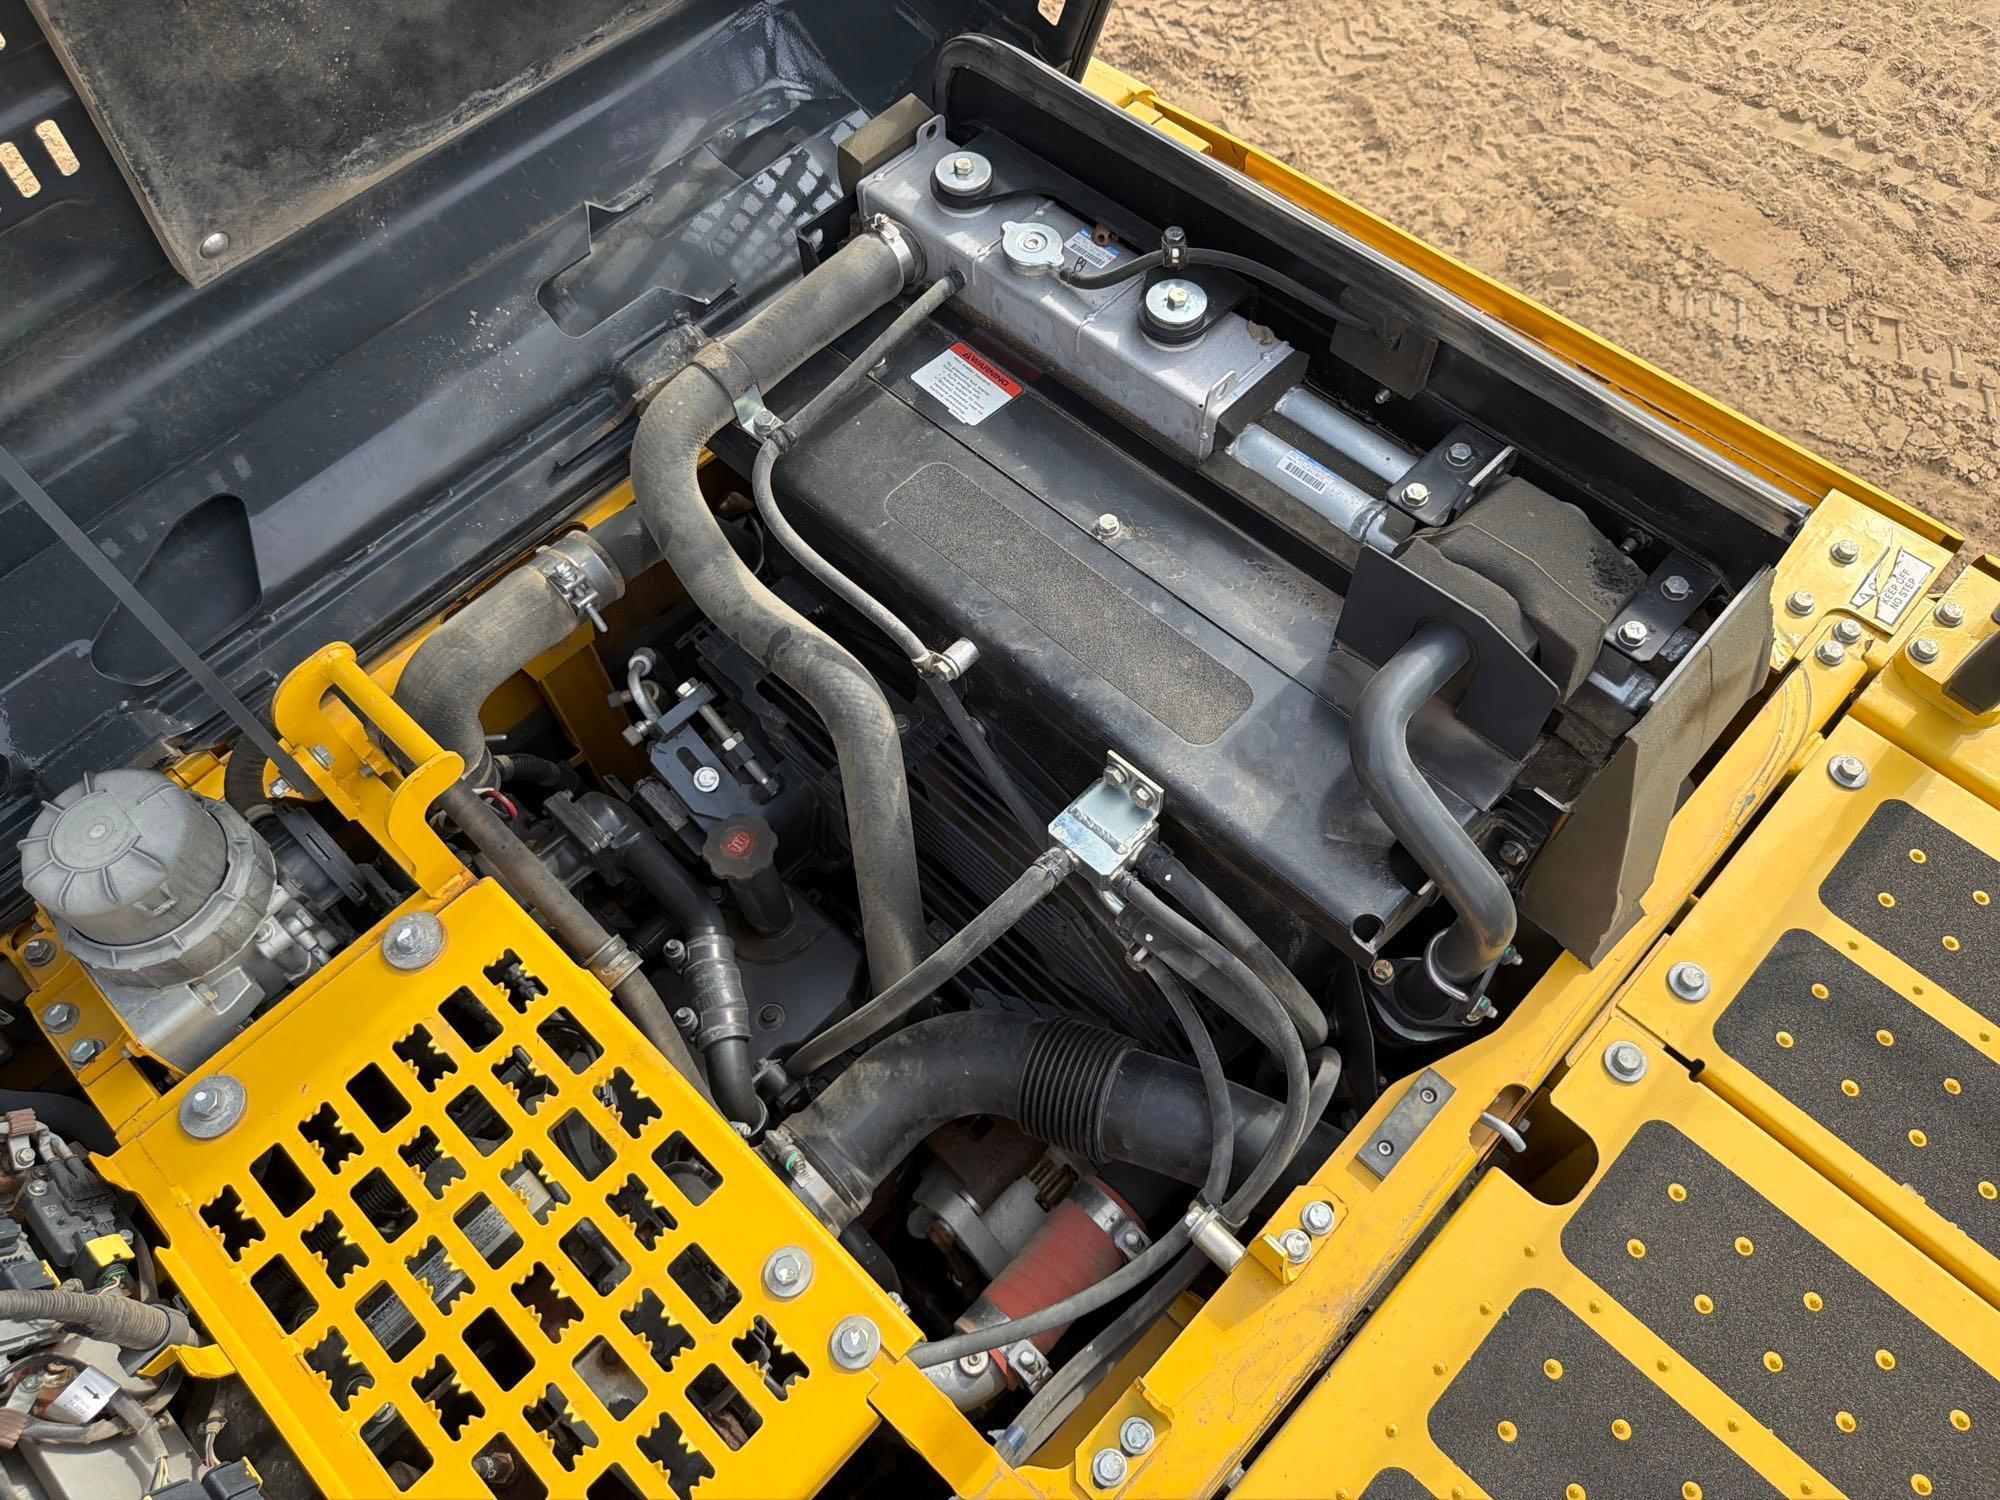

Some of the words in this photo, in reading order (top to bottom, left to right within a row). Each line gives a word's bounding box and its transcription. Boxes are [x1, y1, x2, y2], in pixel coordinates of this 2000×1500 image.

[961, 363, 975, 374] water
[969, 356, 1010, 386] WARNING
[950, 366, 970, 380] prevent
[977, 385, 991, 396] water
[954, 385, 969, 397] water
[955, 381, 973, 394] engine
[947, 393, 969, 410] pressure
[1881, 583, 1898, 605] KEEP
[1895, 568, 1911, 585] OFF
[1889, 597, 1903, 610] NO
[1898, 577, 1916, 598] STEP
